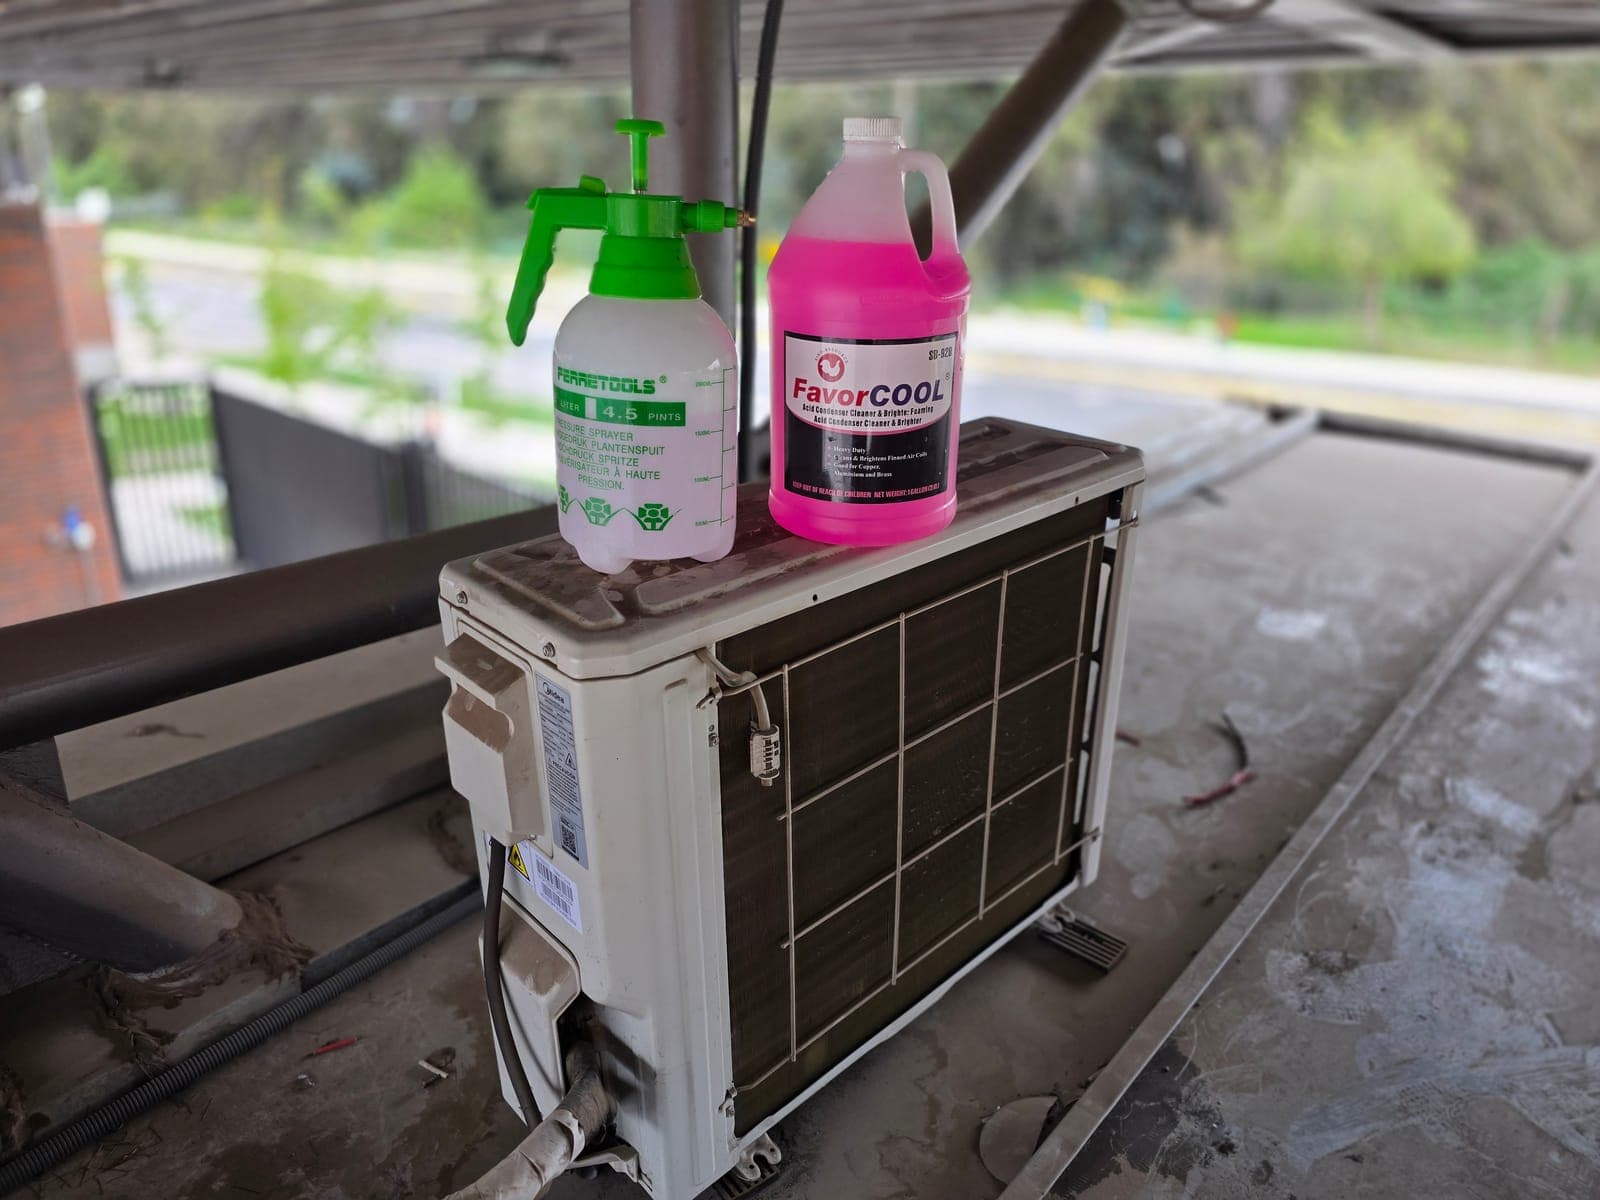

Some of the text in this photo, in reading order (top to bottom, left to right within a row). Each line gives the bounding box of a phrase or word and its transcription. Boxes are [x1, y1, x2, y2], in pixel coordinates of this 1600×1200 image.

[793, 377, 944, 407] FavorCOOL
[603, 406, 638, 421] 4.5
[648, 412, 681, 422] PINTS
[802, 403, 815, 412] Acid
[815, 405, 849, 417] Condenser
[850, 409, 876, 418] Cleaner
[813, 415, 828, 424] Acid
[828, 417, 863, 427] Condenser
[864, 419, 890, 427] Cleaner
[897, 417, 922, 427] Brighter
[588, 427, 634, 442] SPRAYER
[591, 440, 666, 456] PLANTENSPUIT
[598, 453, 639, 467] SPRITZE
[625, 470, 661, 480] HAUTE
